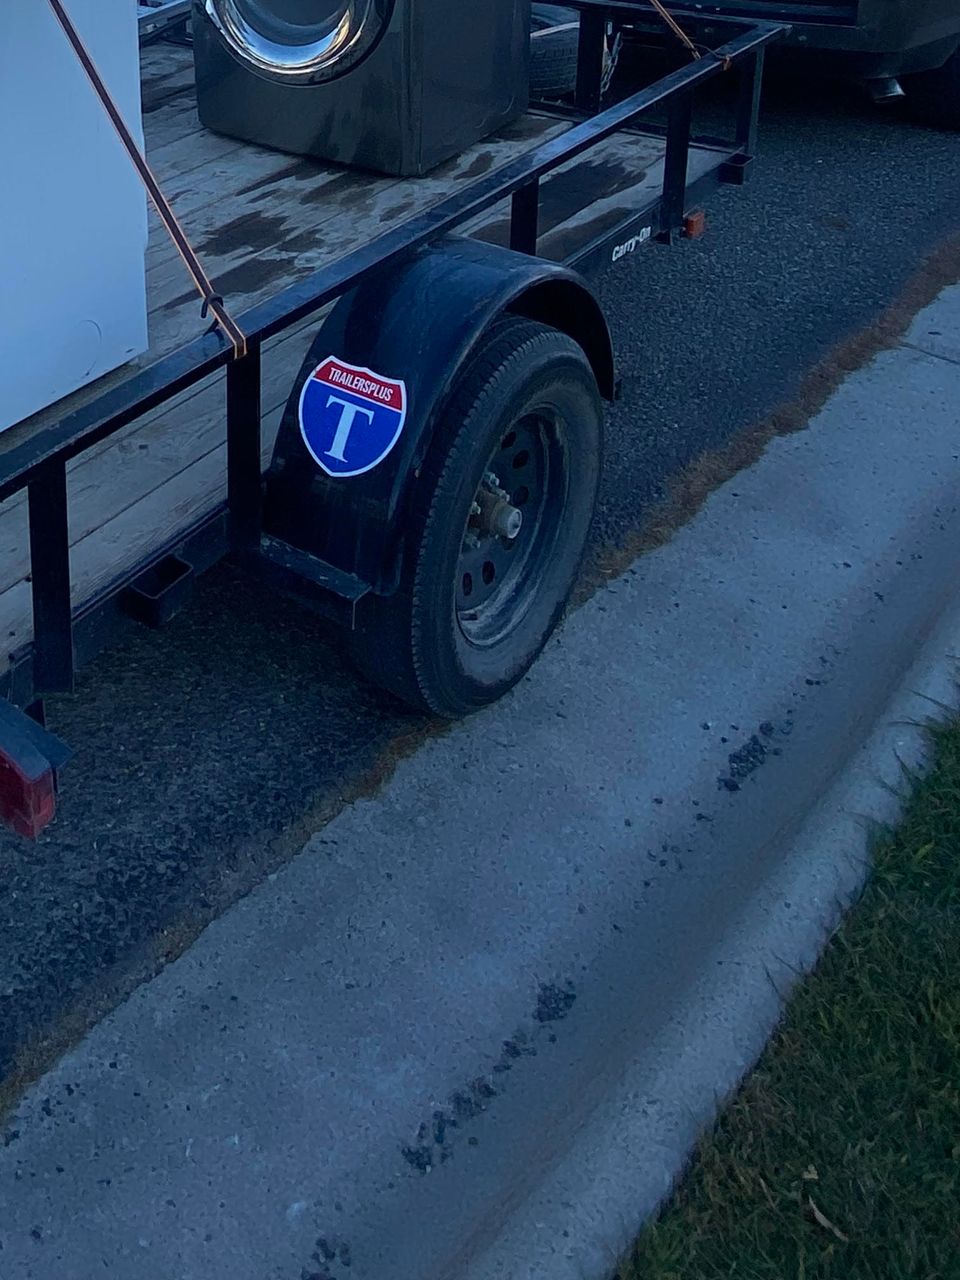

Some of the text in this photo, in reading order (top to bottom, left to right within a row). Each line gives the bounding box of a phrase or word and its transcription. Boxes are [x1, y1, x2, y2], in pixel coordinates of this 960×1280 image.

[611, 226, 651, 262] Carry-On
[328, 367, 394, 402] TRAILERSPLUS
[324, 394, 375, 463] T
